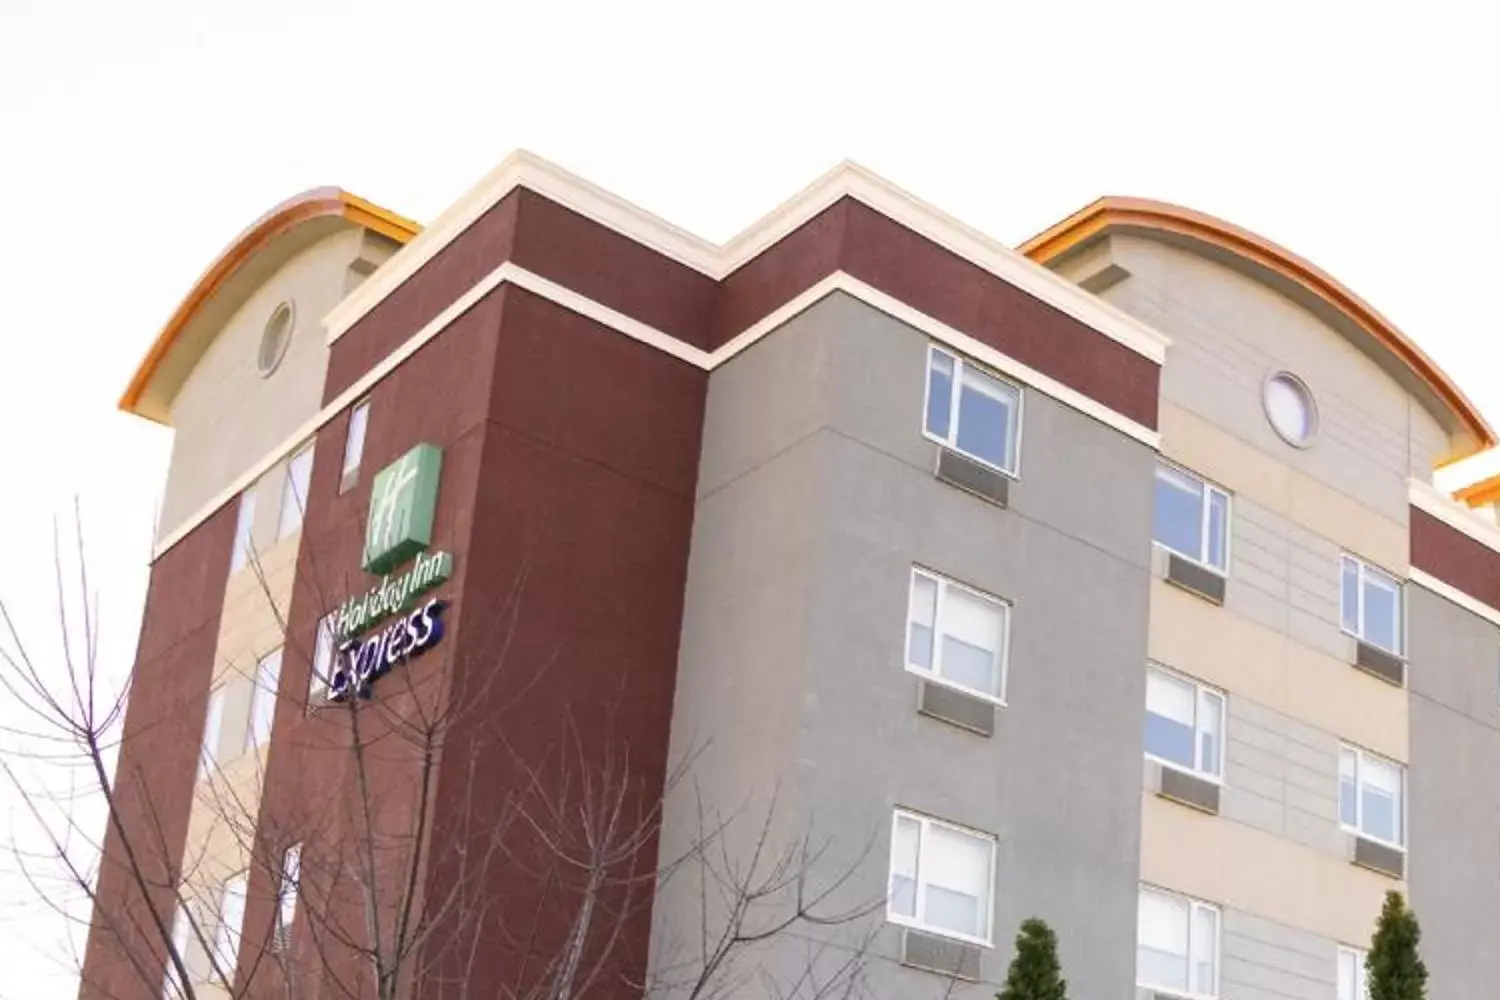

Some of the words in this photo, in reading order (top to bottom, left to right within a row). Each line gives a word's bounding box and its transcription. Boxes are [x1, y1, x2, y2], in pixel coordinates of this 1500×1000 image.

[338, 572, 411, 637] Holiday
[409, 550, 446, 594] Inn
[327, 597, 440, 700] Express
